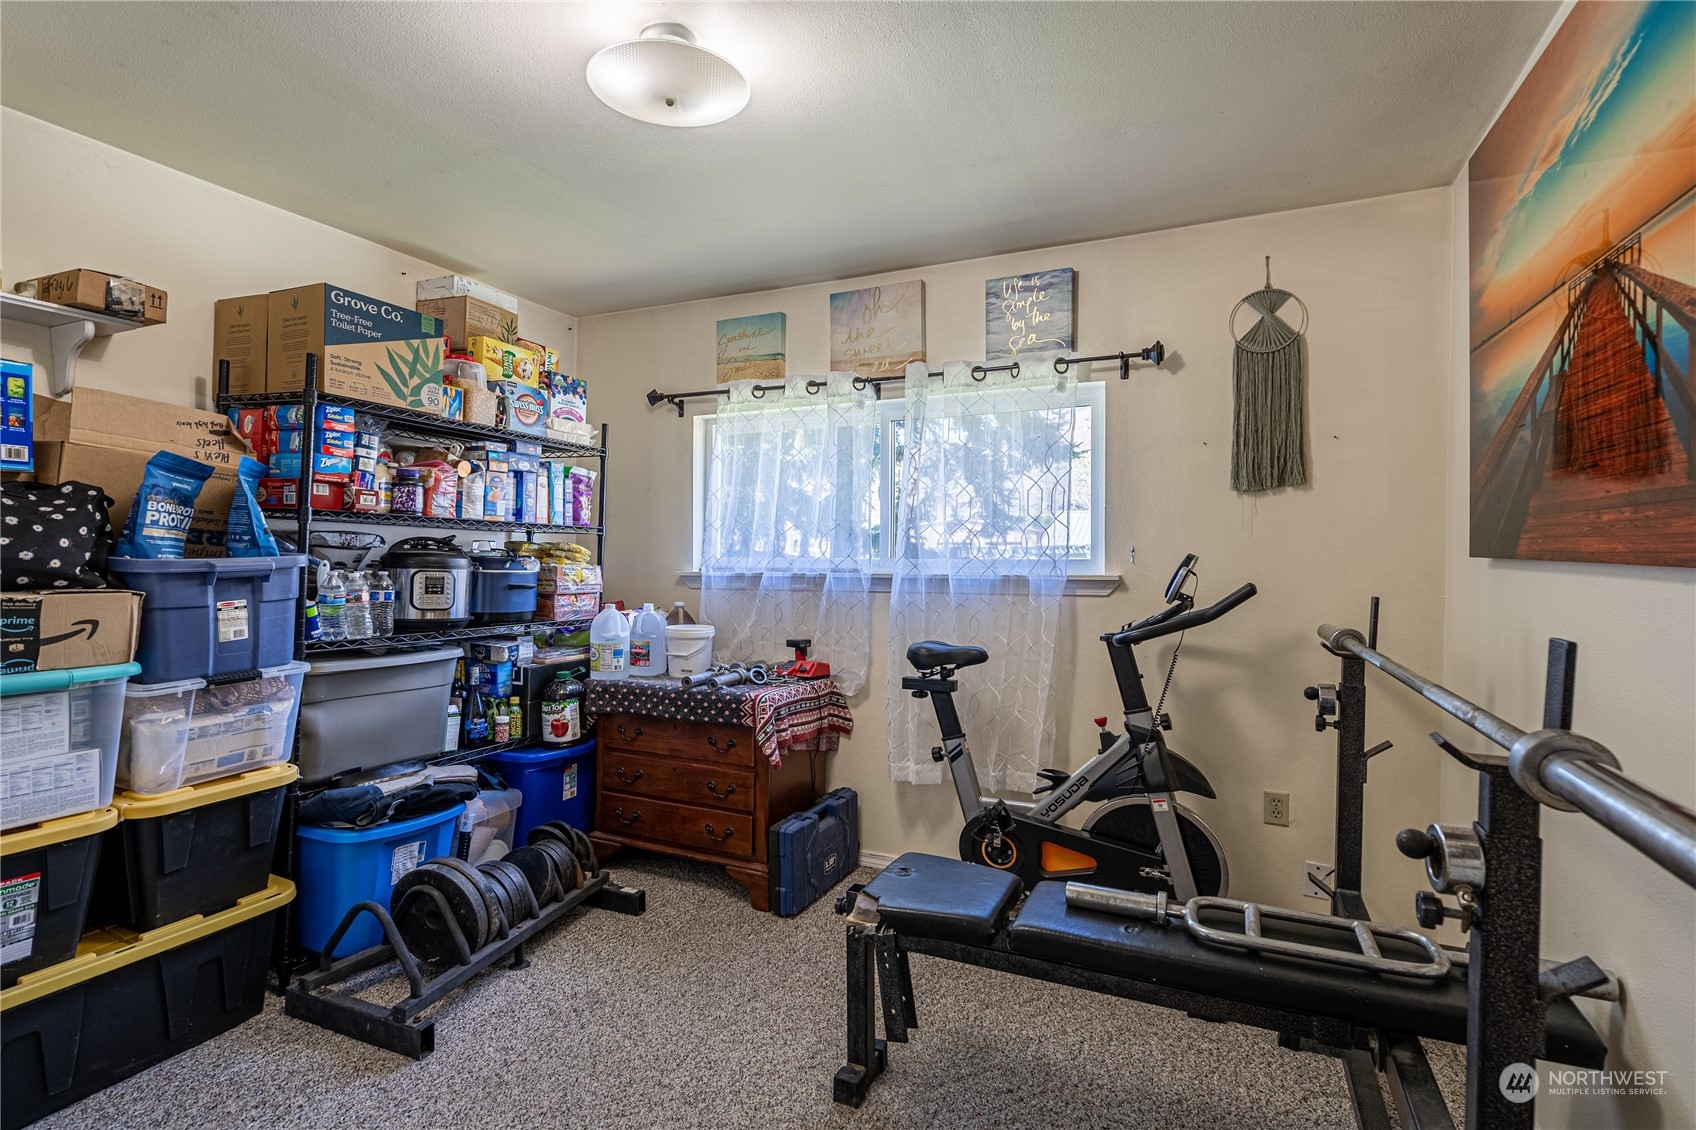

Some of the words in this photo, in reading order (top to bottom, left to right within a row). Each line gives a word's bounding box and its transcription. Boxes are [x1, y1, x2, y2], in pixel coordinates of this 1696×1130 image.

[1003, 278, 1024, 301] Life
[1031, 275, 1041, 286] is
[330, 290, 378, 315] Grove
[381, 305, 404, 323] Co.
[330, 308, 373, 328] Tree-Free
[1011, 318, 1025, 337] by
[1025, 306, 1053, 326] the
[330, 318, 356, 332] Toilet
[357, 325, 382, 339] Paper
[335, 367, 355, 377] branch
[427, 396, 440, 406] 90
[195, 438, 225, 450] Heels
[320, 457, 344, 468] Ziploc
[192, 515, 221, 526] Selecte
[185, 547, 225, 557] Impe
[0, 616, 35, 627] prime
[1040, 776, 1089, 818] YOSUDA
[6, 900, 14, 908] 12
